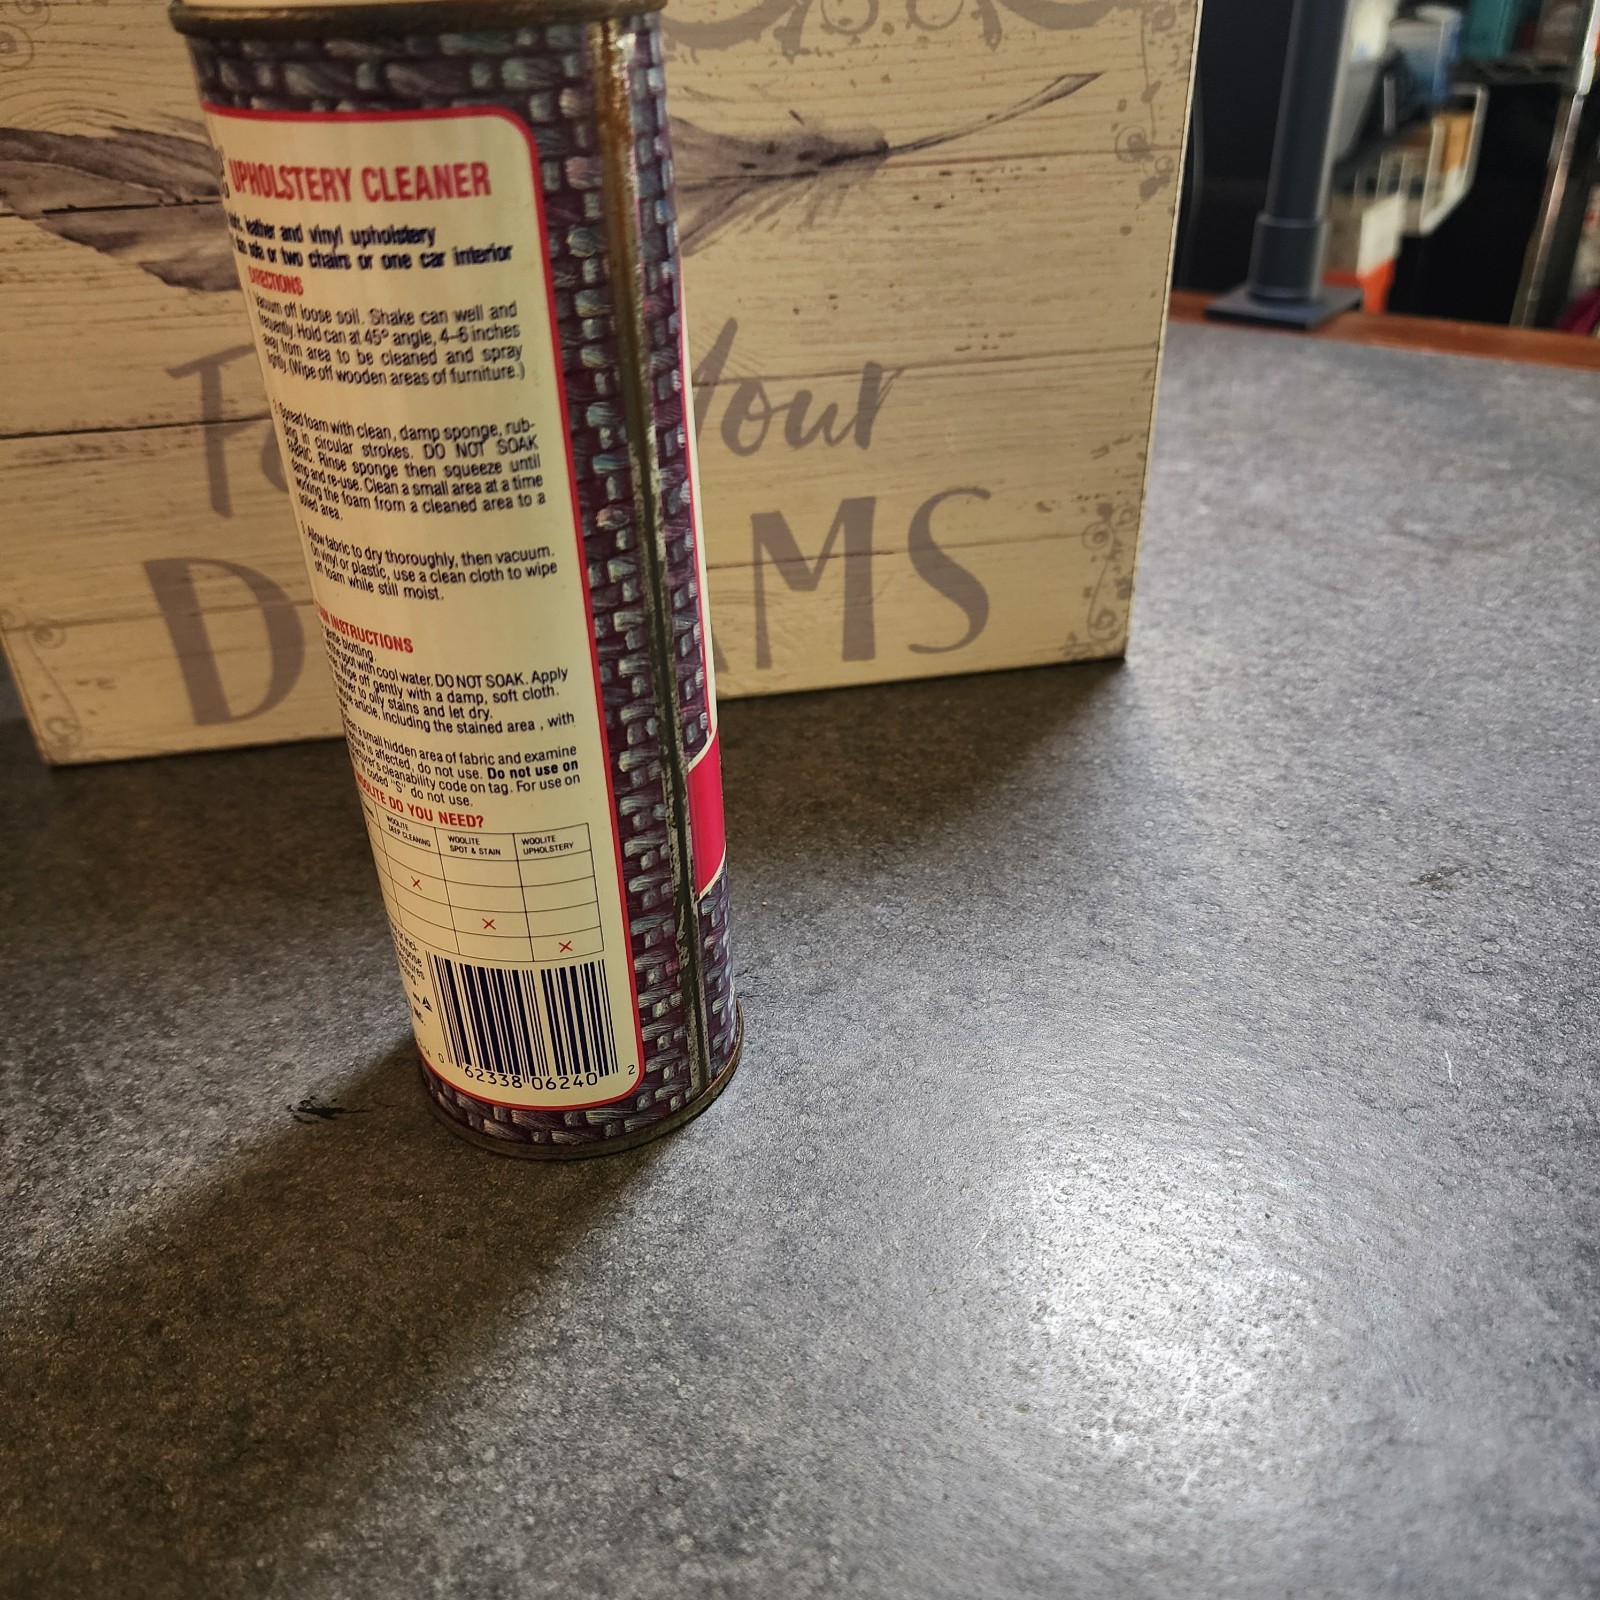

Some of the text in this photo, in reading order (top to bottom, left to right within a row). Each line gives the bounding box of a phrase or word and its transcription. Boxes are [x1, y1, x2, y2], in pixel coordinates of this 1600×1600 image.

[229, 159, 352, 202] UPHOLSTERY
[361, 161, 492, 203] CLEANER
[351, 224, 436, 249] upholstery
[381, 243, 513, 270] one car interior
[300, 300, 518, 326] loose soil. Shake can well and
[297, 323, 322, 342] Hold
[324, 329, 346, 344] can
[348, 330, 361, 345] at
[393, 328, 437, 349] angle,
[471, 324, 521, 342] inches
[307, 345, 522, 366] area to be cleaned and spray
[319, 364, 447, 386] off wooden areas of
[304, 413, 535, 443] foam with clean, damp sponge, rub-
[302, 428, 540, 461] in circular strokes. DO NOT SOAK
[317, 451, 542, 481] Rinse sponge then squeeze until
[327, 473, 545, 497] re-use. Clean a small area at a time
[320, 502, 344, 522] area.
[323, 485, 546, 514] the foam from a cleaned area to a
[325, 534, 556, 570] fabric to dry thoroughly, then vacuum.
[339, 557, 559, 584] or plastic, use a clean cloth to wipe
[348, 575, 444, 602] while still moist.
[329, 613, 415, 654] INSTRUCTIONS
[356, 658, 376, 676] with
[375, 669, 400, 684] cool
[400, 672, 434, 688] water.
[434, 673, 456, 689] DO
[456, 674, 483, 689] NOT
[485, 672, 529, 688] SOAK.
[531, 667, 569, 686] Apply
[359, 673, 371, 688] off
[372, 679, 404, 700] gently
[406, 688, 432, 702] with
[435, 691, 444, 704] a
[446, 690, 488, 706] damp,
[492, 689, 519, 704] soft
[521, 685, 560, 701] cloth.
[357, 686, 367, 700] to
[368, 691, 385, 711] oily
[387, 698, 420, 716] stains
[422, 703, 446, 719] and
[448, 705, 466, 719] let
[467, 706, 494, 722] dry.
[382, 709, 575, 735] including the stained with
[363, 731, 384, 748] small
[384, 738, 418, 758] hidden
[419, 750, 443, 763] area
[445, 751, 457, 764] of
[459, 752, 496, 766] fabric
[498, 752, 523, 765] and
[524, 745, 578, 764] examine
[381, 764, 436, 790] cleanability
[439, 779, 468, 792] code
[470, 778, 486, 793] on
[488, 781, 515, 796] tag.
[515, 780, 537, 793] For
[539, 779, 562, 791] use
[564, 773, 581, 786] on
[417, 760, 579, 780] do not use. Do not use on
[410, 786, 424, 800] do
[427, 789, 446, 804] not
[448, 794, 473, 807] use.
[386, 814, 409, 831] WOOLITE
[388, 795, 405, 813] DO
[406, 802, 434, 823] YOU
[437, 810, 485, 829] NEED?
[447, 834, 481, 846] WOOLITE
[449, 844, 470, 855] SPOT
[478, 847, 502, 857] STAIN
[521, 834, 557, 846] WOOLITE
[522, 841, 575, 856] UPHOLSTERY
[464, 1065, 522, 1089] 62338
[532, 1072, 598, 1090] 06240
[627, 1064, 636, 1075] 2
